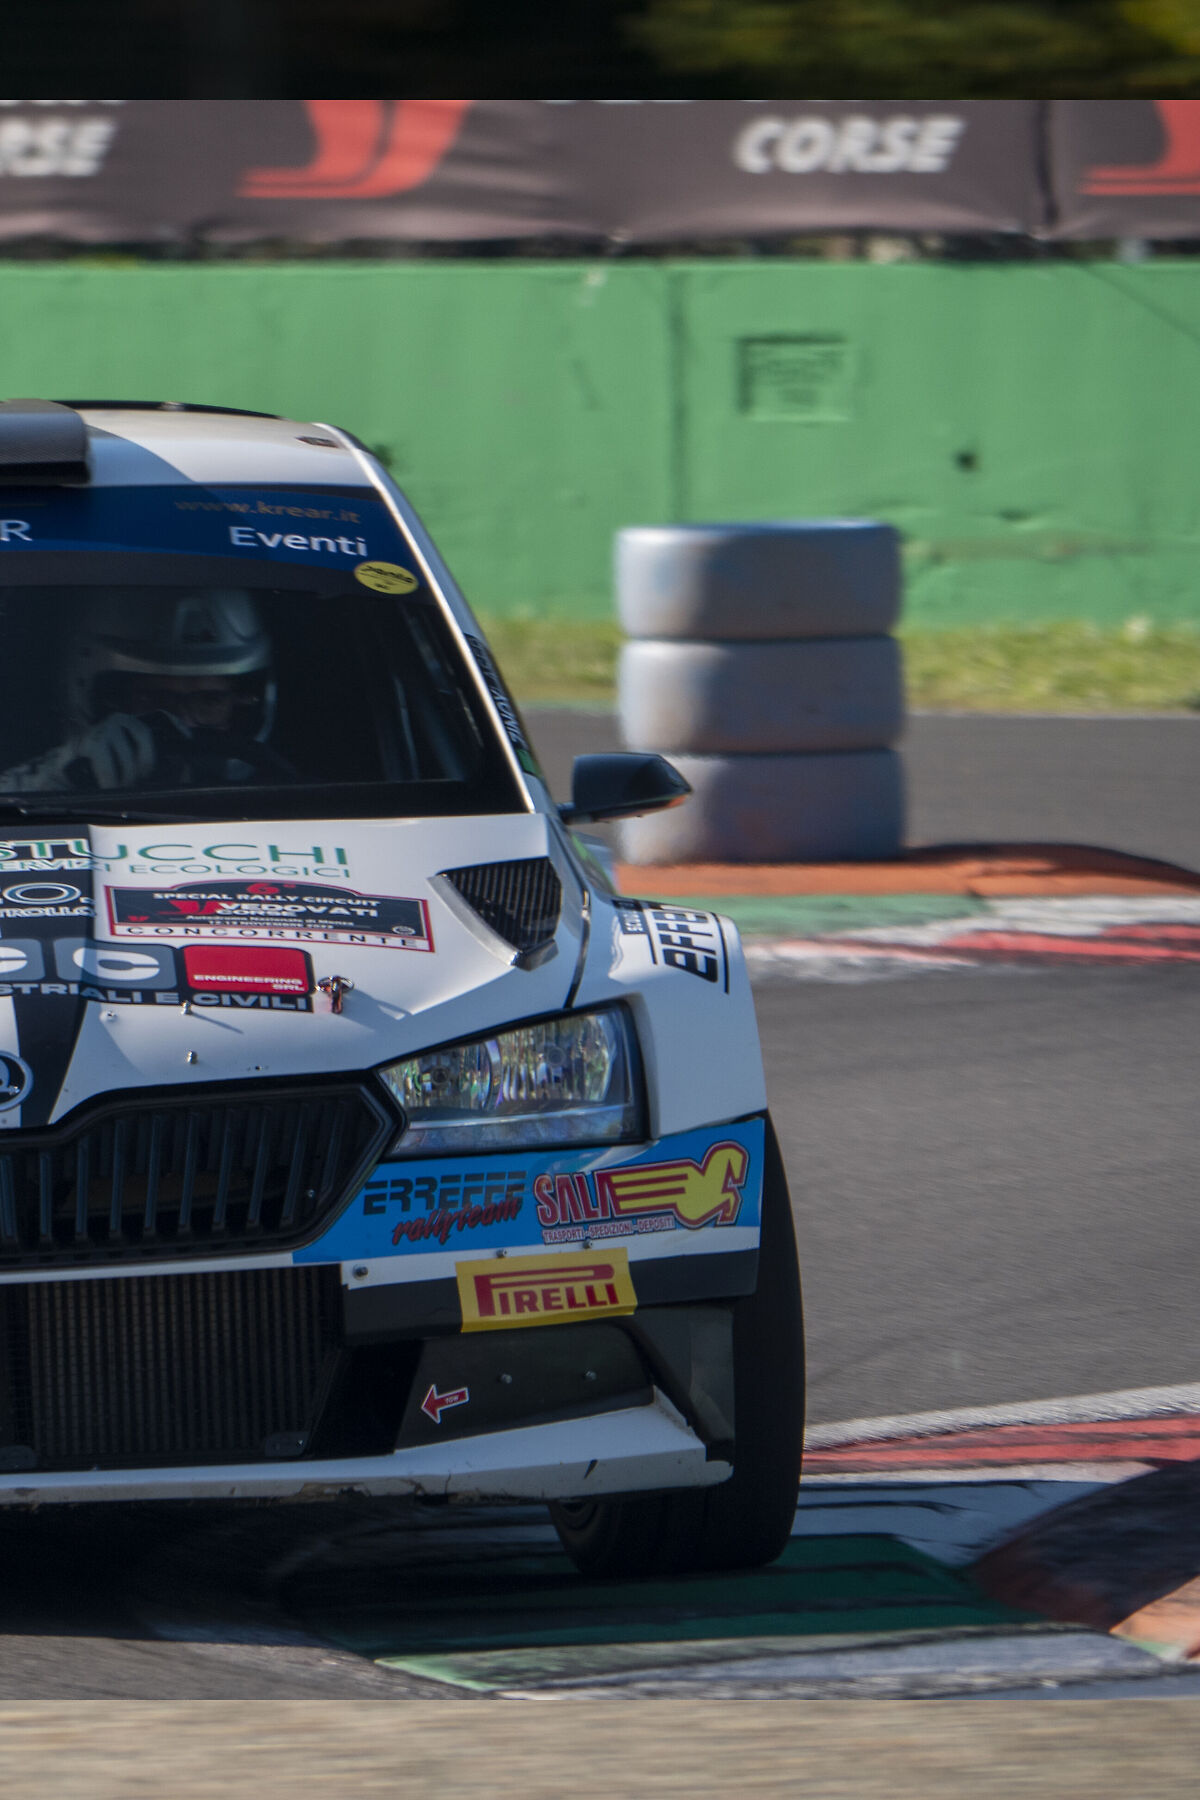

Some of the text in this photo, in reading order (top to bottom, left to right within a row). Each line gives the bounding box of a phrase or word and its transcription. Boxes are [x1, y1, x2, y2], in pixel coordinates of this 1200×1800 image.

[734, 116, 965, 174] CORSE
[229, 526, 368, 556] Eventi
[129, 864, 351, 878] ECOLOGICI
[236, 893, 299, 901] RALLY
[303, 896, 381, 907] CIRCUIT
[215, 909, 298, 917] CORSE
[217, 901, 378, 918] VEDOVATI
[127, 926, 418, 948] CONCORRENTE
[193, 974, 303, 985] ENGINEERING
[271, 984, 306, 992] SRL
[155, 991, 179, 1005] E
[192, 993, 308, 1011] CIVILI
[473, 1263, 620, 1317] PIRELLI
